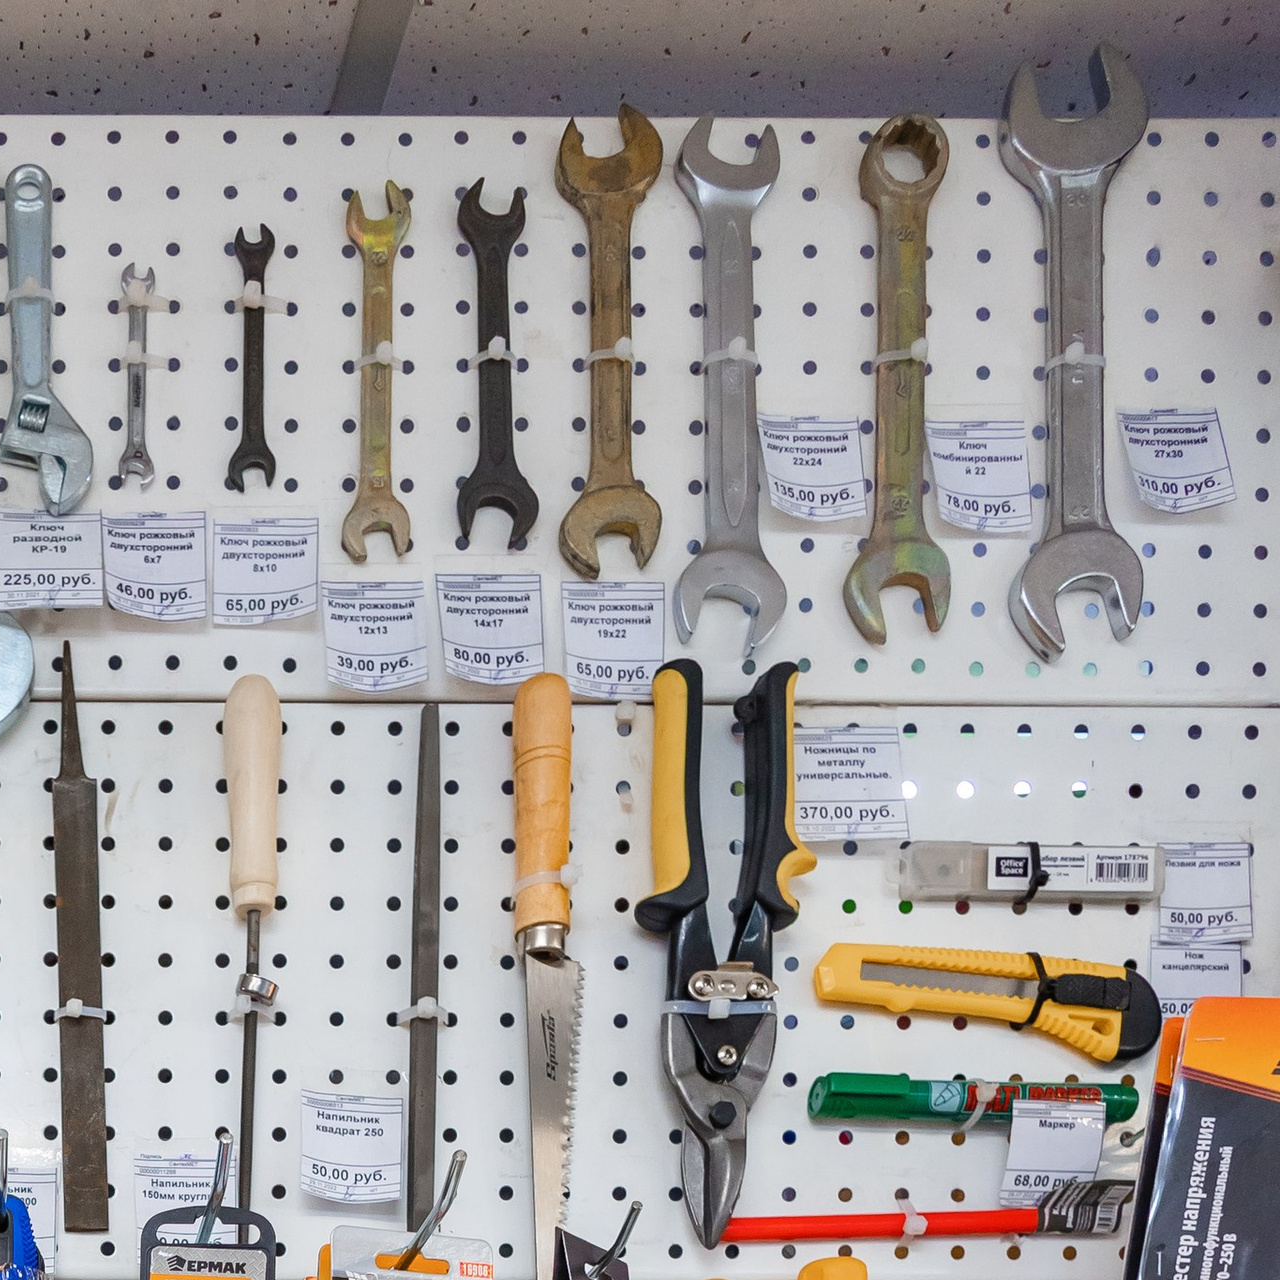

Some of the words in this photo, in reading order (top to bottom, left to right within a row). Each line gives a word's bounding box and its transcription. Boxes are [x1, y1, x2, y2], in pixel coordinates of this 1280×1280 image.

[12, 534, 82, 545] разводной
[32, 545, 66, 555] КР-19
[3, 573, 56, 588] 225,00
[61, 574, 96, 590] руб.
[804, 745, 859, 757] Ножницы
[862, 746, 876, 757] по
[800, 805, 854, 820] 370,00
[860, 806, 895, 822] руб.
[318, 1111, 380, 1125] Напильник
[312, 1164, 352, 1181] 50,00
[356, 1169, 387, 1184] руб.
[1182, 1117, 1217, 1230] напряжения
